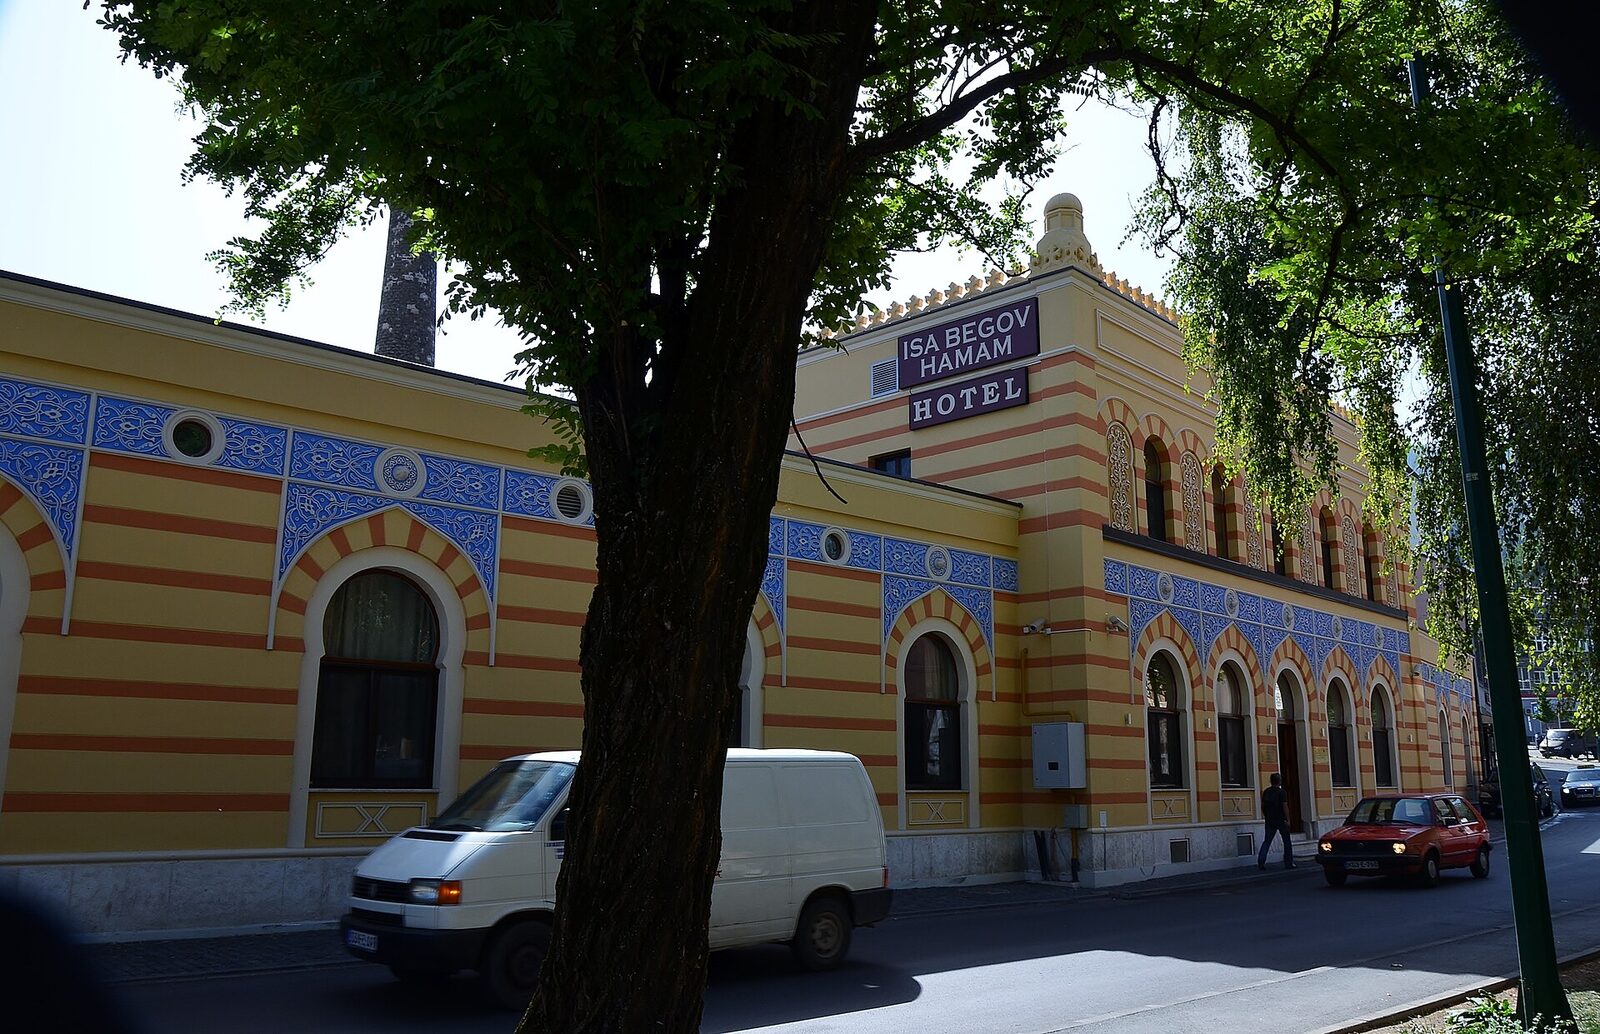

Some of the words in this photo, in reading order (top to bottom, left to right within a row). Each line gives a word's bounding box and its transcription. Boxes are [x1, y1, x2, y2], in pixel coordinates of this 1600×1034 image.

[903, 334, 940, 360] ISA
[945, 305, 1031, 348] BEGOV
[920, 335, 1012, 377] HAMAM
[913, 378, 1022, 421] HOTEL
